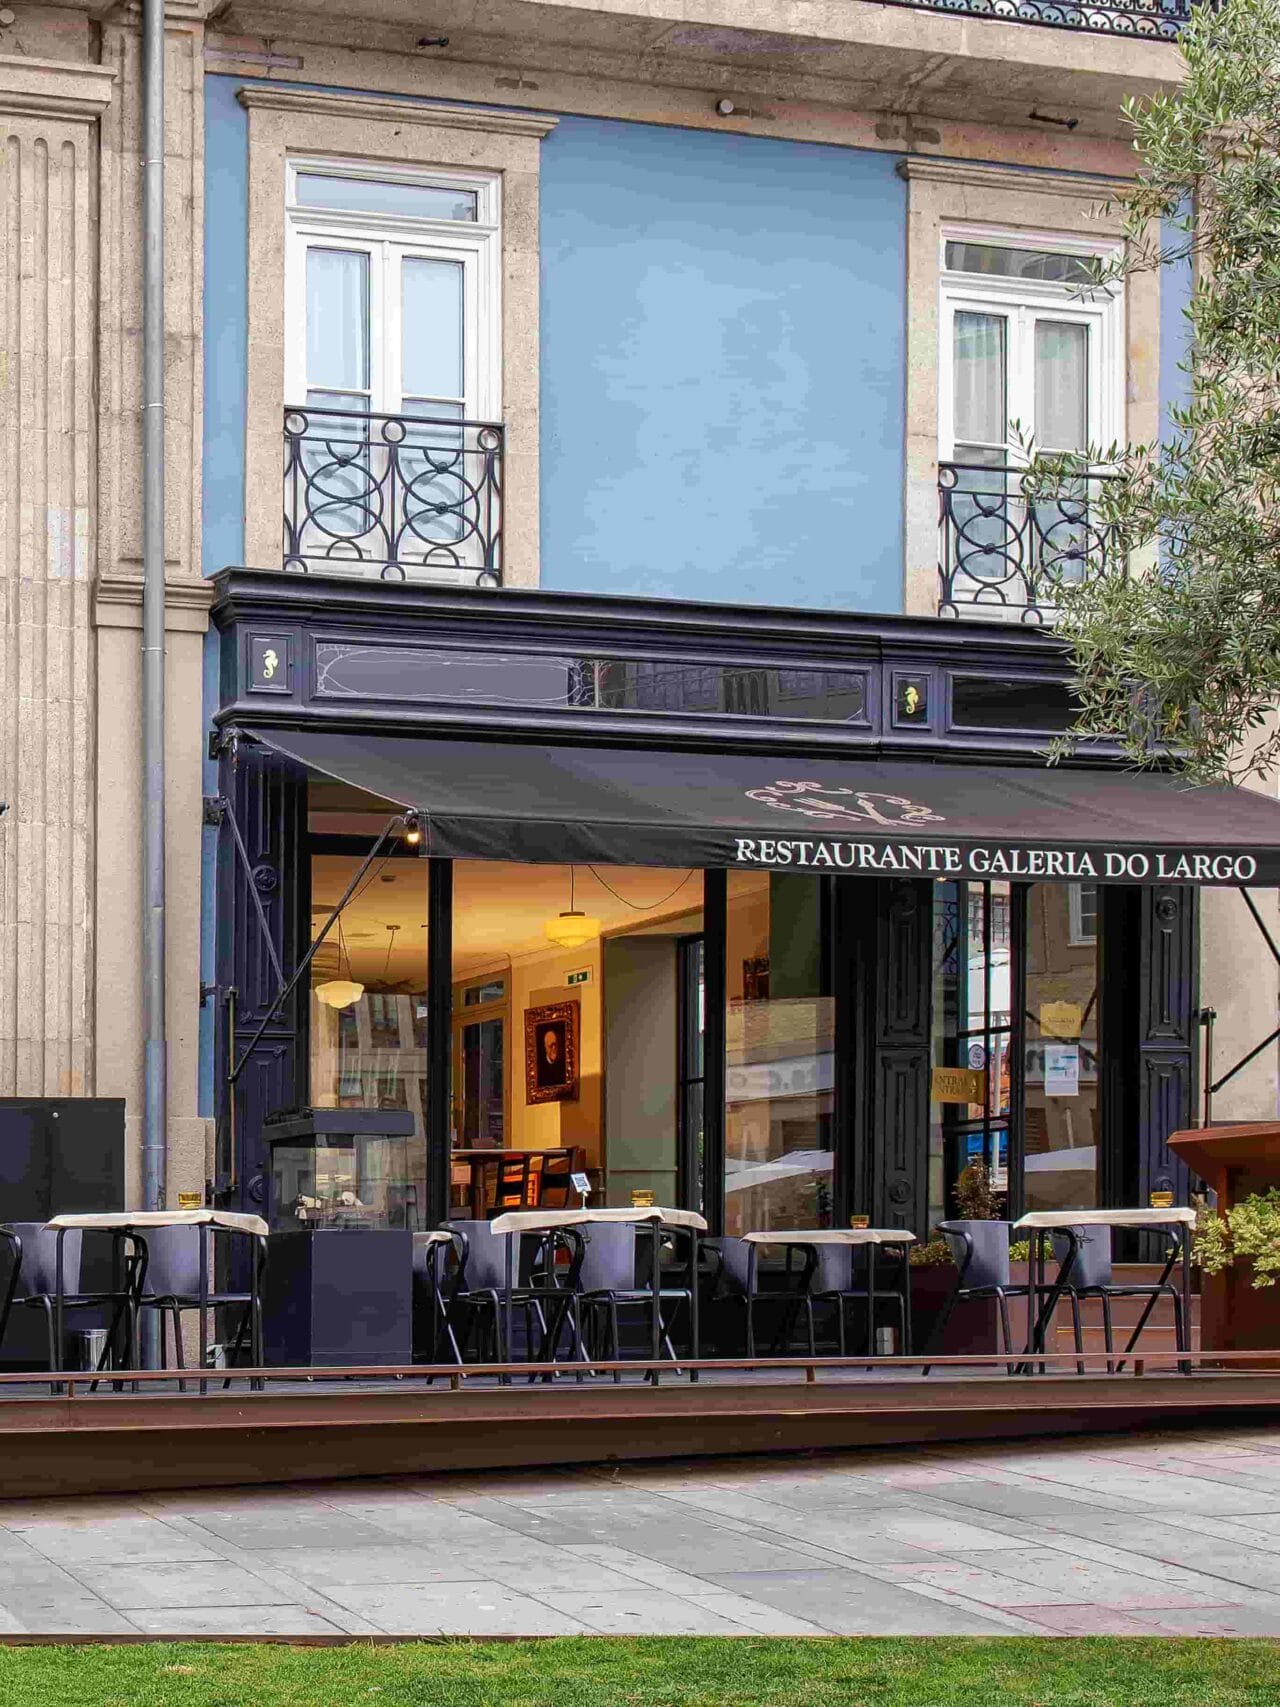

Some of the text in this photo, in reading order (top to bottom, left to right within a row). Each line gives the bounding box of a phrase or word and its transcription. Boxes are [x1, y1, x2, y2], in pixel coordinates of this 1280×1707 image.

[734, 837, 1257, 880] RESTAURANTE GALERIA DO LARGO
